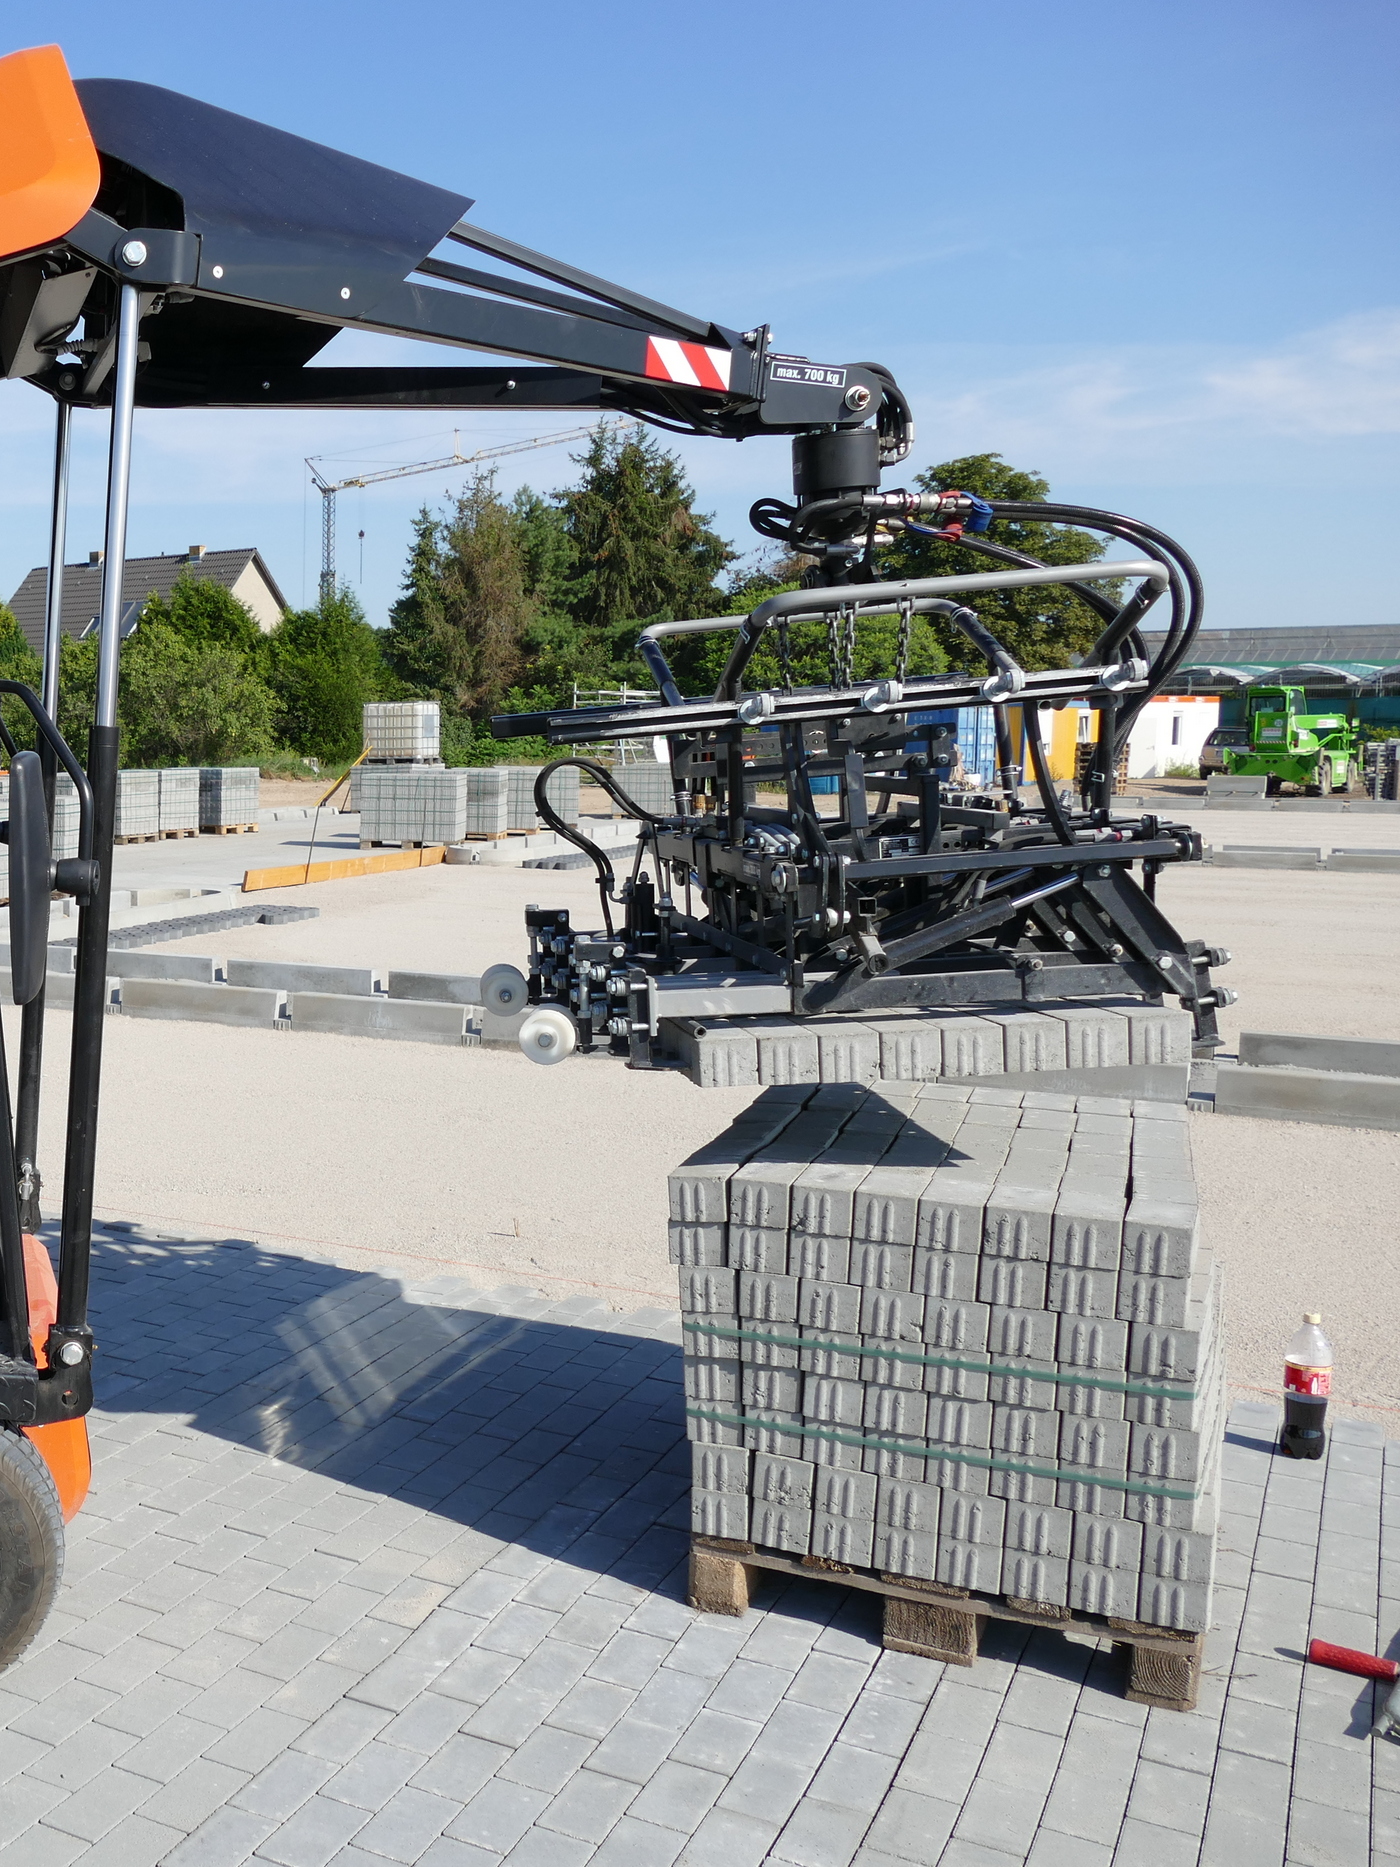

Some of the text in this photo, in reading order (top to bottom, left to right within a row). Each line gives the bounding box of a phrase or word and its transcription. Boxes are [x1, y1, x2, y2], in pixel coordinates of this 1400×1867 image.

[777, 367, 840, 385] max. 700 kg
